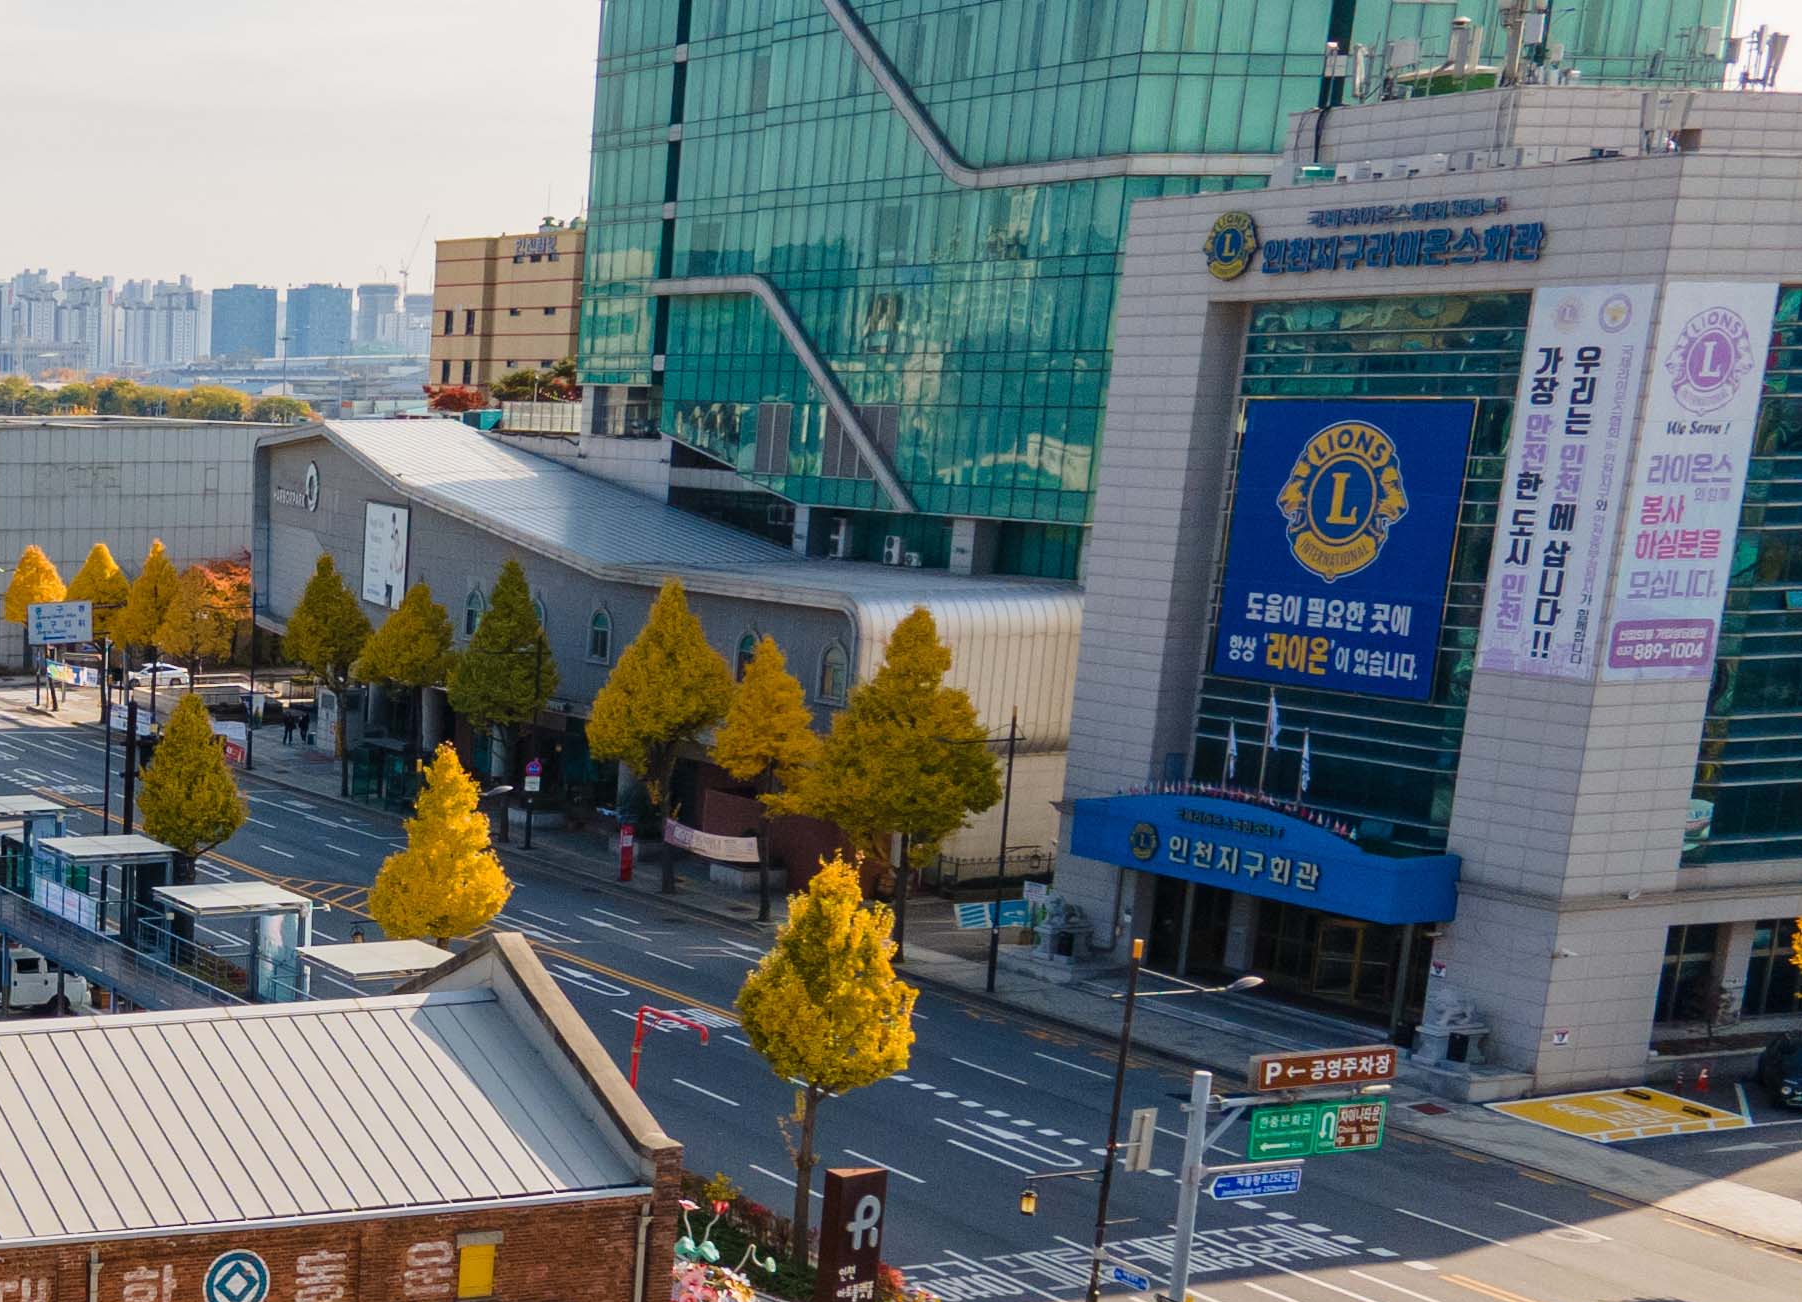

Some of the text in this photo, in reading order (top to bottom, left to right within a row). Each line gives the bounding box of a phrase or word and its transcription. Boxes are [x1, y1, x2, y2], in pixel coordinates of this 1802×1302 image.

[1261, 222, 1545, 274] 인천지구라이온스회관
[1691, 311, 1742, 334] LIONS
[1530, 347, 1563, 405] 가장
[1698, 341, 1721, 378] L
[1564, 346, 1601, 435] 우리는
[1313, 429, 1388, 462] LIONS
[1666, 420, 1687, 435] We
[1647, 453, 1734, 484] 라이온스
[1325, 472, 1358, 525] L
[1548, 444, 1585, 531] 인천에
[1641, 495, 1685, 525] 봉사
[1299, 539, 1371, 569] INTERNATIONAL
[1504, 509, 1536, 566] 도시
[1634, 529, 1722, 560] 하실분을
[1533, 540, 1571, 626] 삽니다
[1245, 592, 1412, 637] 도움이 필요한 곳에
[1497, 574, 1526, 632] 인천
[1229, 634, 1257, 662] 항상
[1633, 642, 1704, 661] 889-1004
[1168, 835, 1319, 891] 인천지구회관
[1310, 1054, 1391, 1081] 공영주차장
